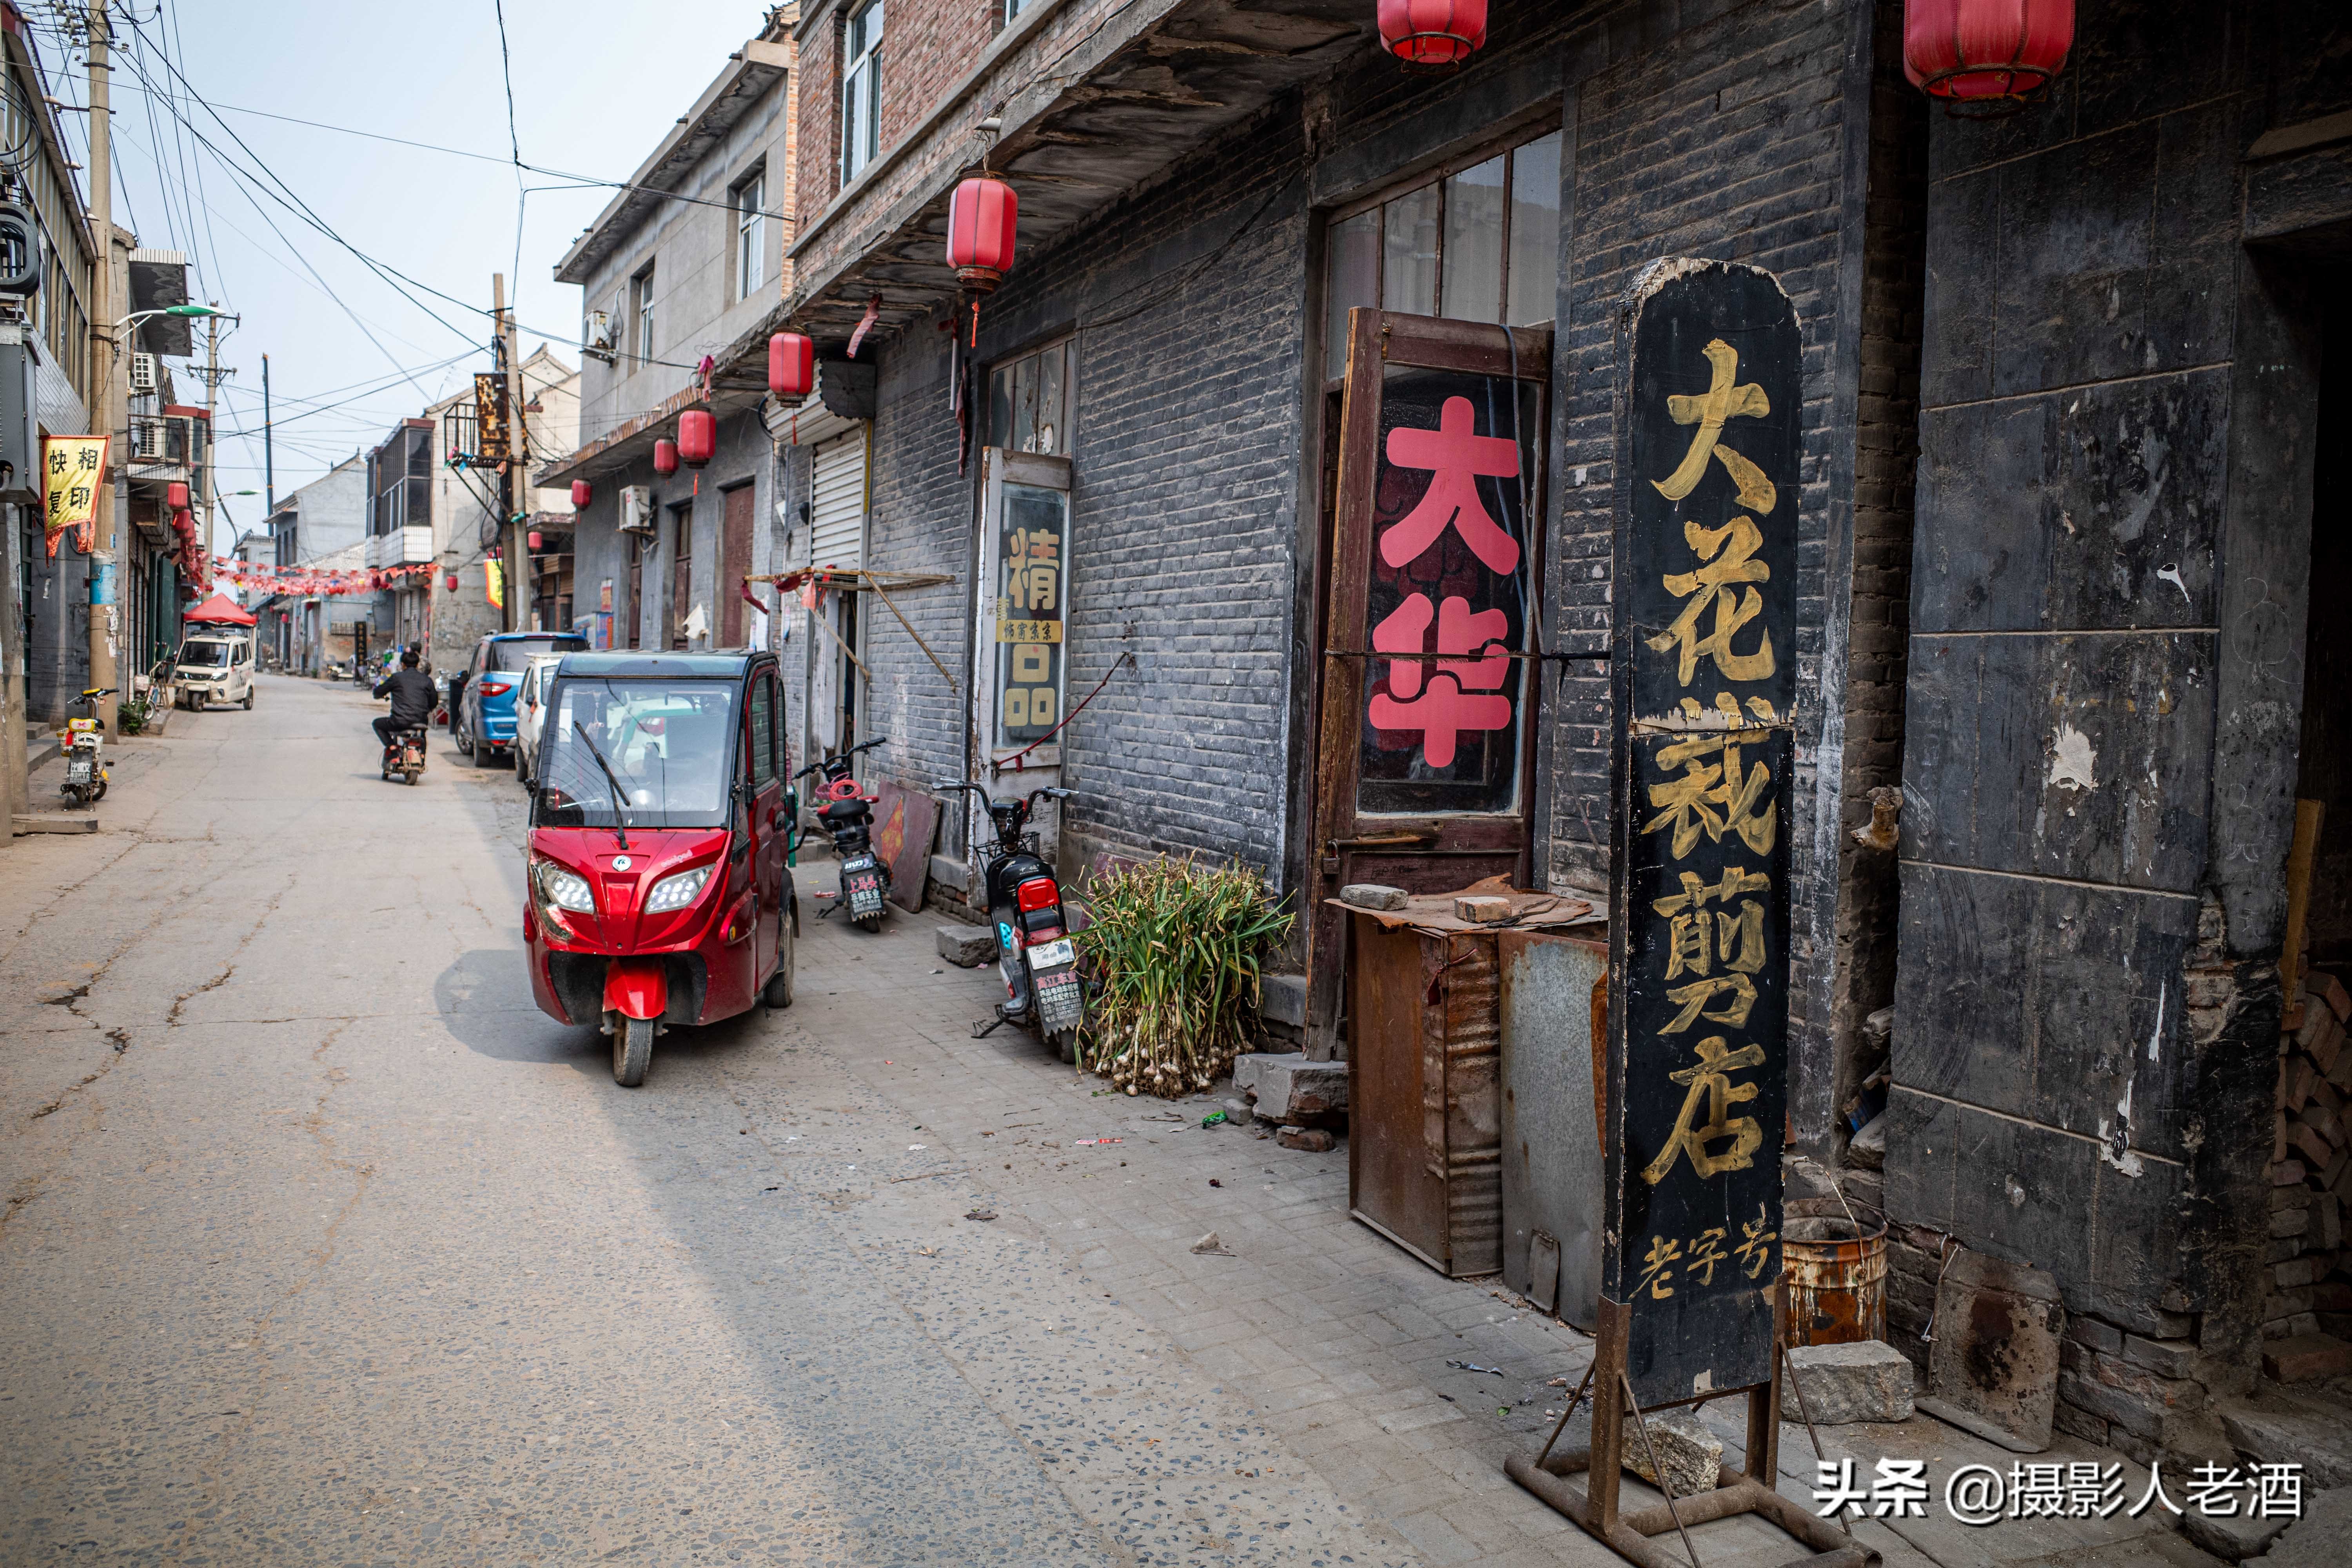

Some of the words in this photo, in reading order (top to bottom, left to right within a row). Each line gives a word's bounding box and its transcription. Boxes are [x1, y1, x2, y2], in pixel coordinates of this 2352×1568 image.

[1004, 527, 1059, 726] 精品
[1369, 396, 1523, 768] 大华
[1641, 338, 1777, 1186] 大花裁剪店
[1628, 1201, 1776, 1299] 老字号
